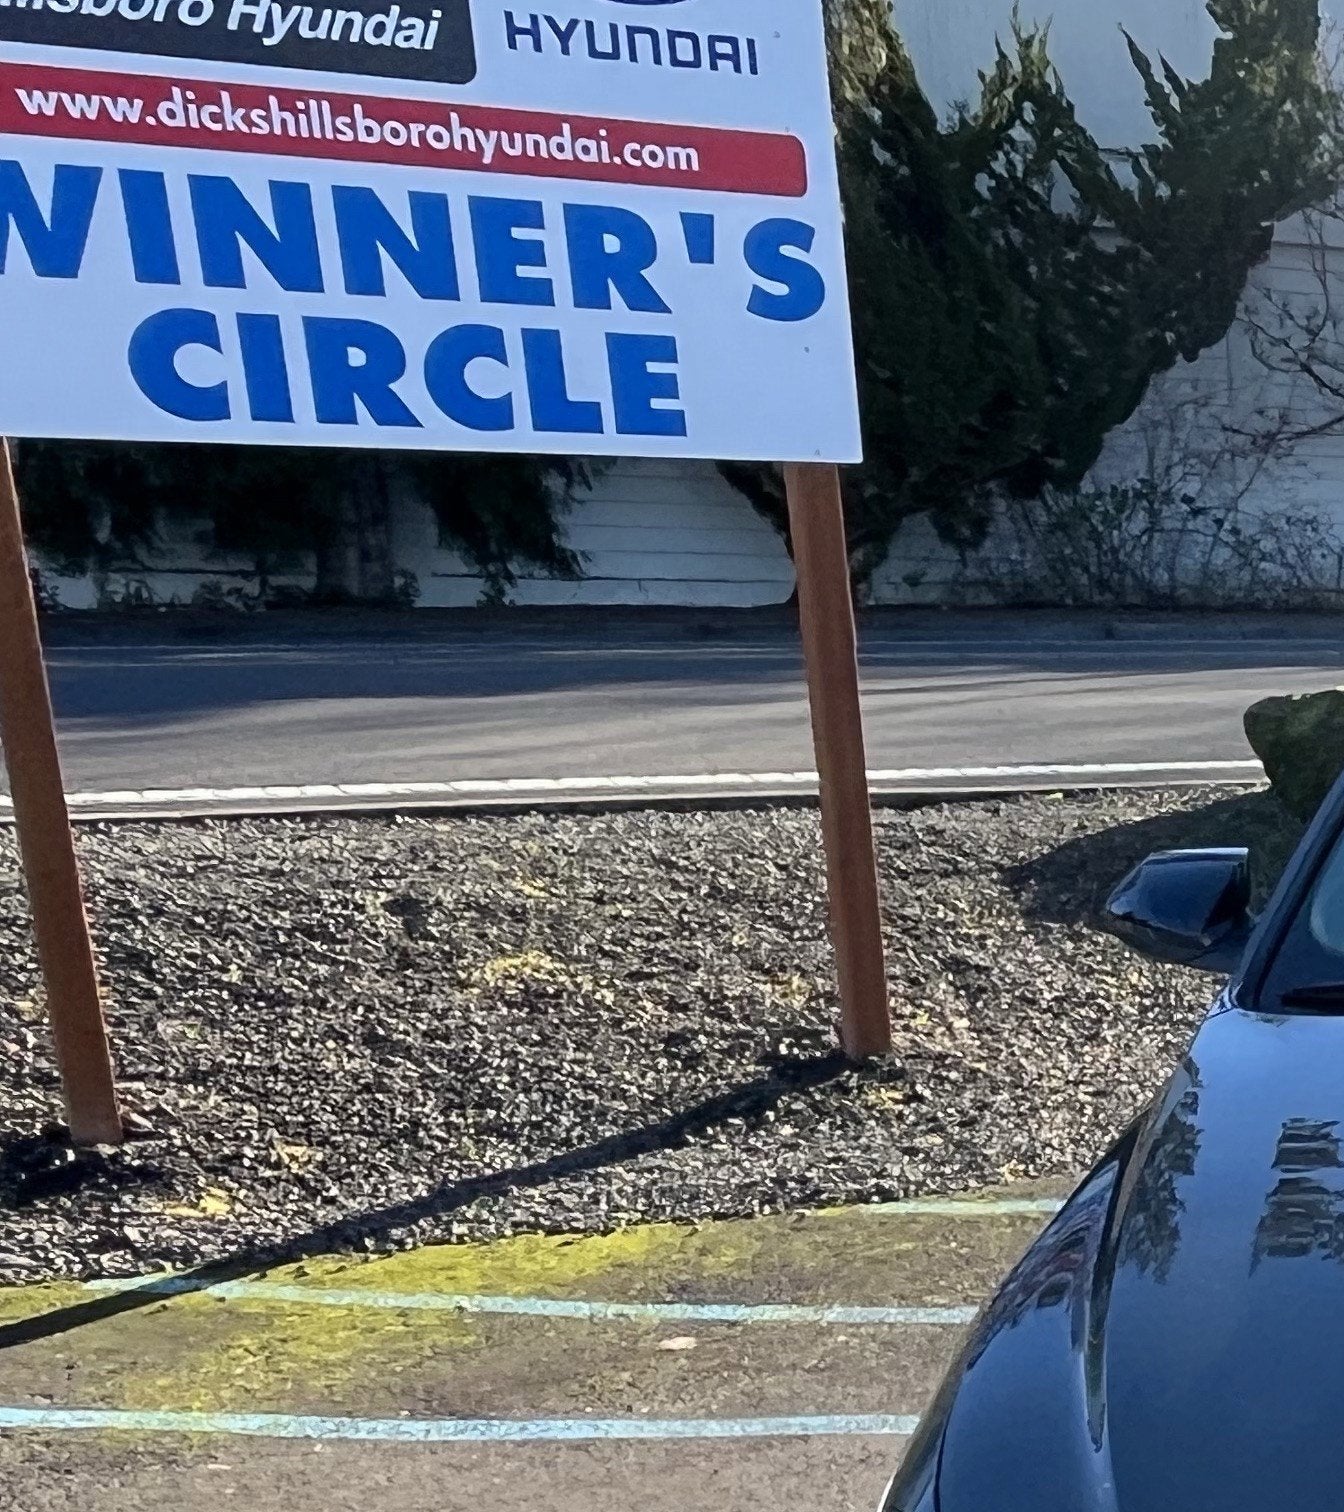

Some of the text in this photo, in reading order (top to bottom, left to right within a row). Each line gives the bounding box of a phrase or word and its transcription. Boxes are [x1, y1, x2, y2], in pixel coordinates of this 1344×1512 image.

[227, 0, 442, 50] Hyundai
[504, 10, 758, 75] HYUNDAI
[15, 84, 700, 173] www.dickshillsborohyundai.com
[128, 308, 687, 437] CIRCLE
